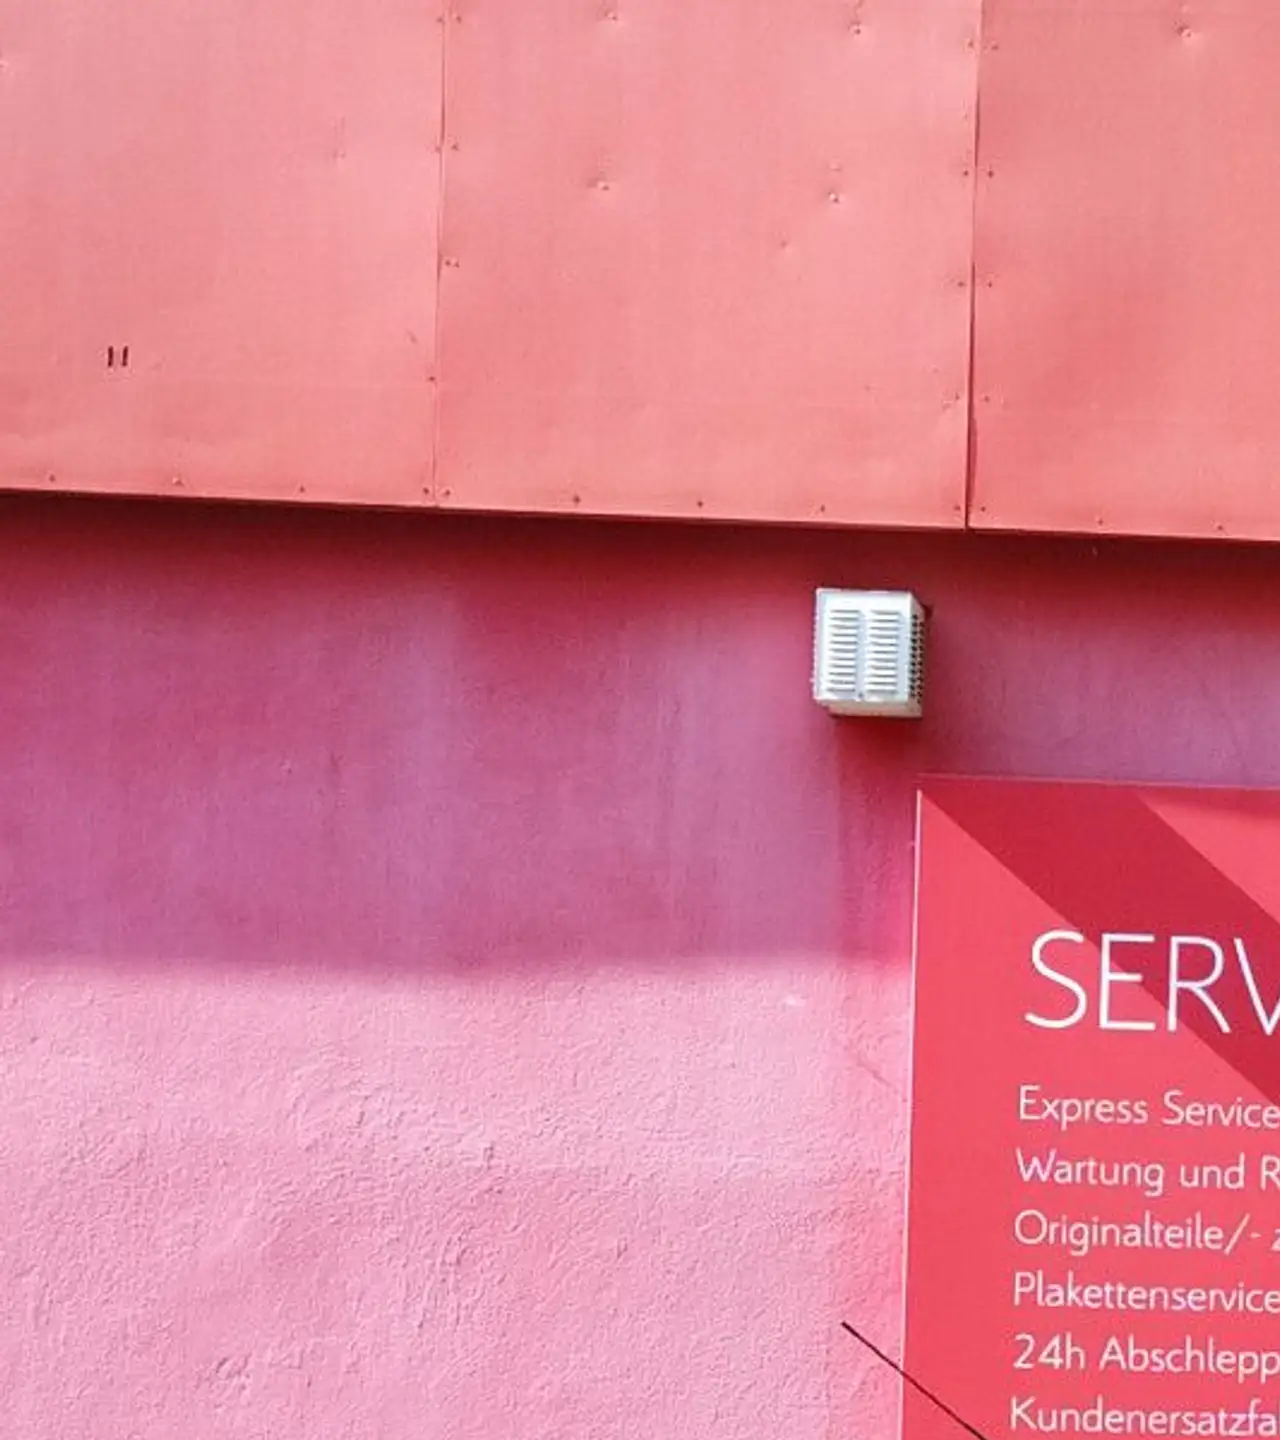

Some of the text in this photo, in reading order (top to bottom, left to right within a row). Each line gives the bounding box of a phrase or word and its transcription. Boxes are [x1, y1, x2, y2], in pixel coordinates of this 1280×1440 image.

[1018, 1084, 1149, 1131] Express
[1016, 1147, 1165, 1198] Wartung
[1178, 1152, 1246, 1190] und
[1013, 1331, 1087, 1371] 24h
